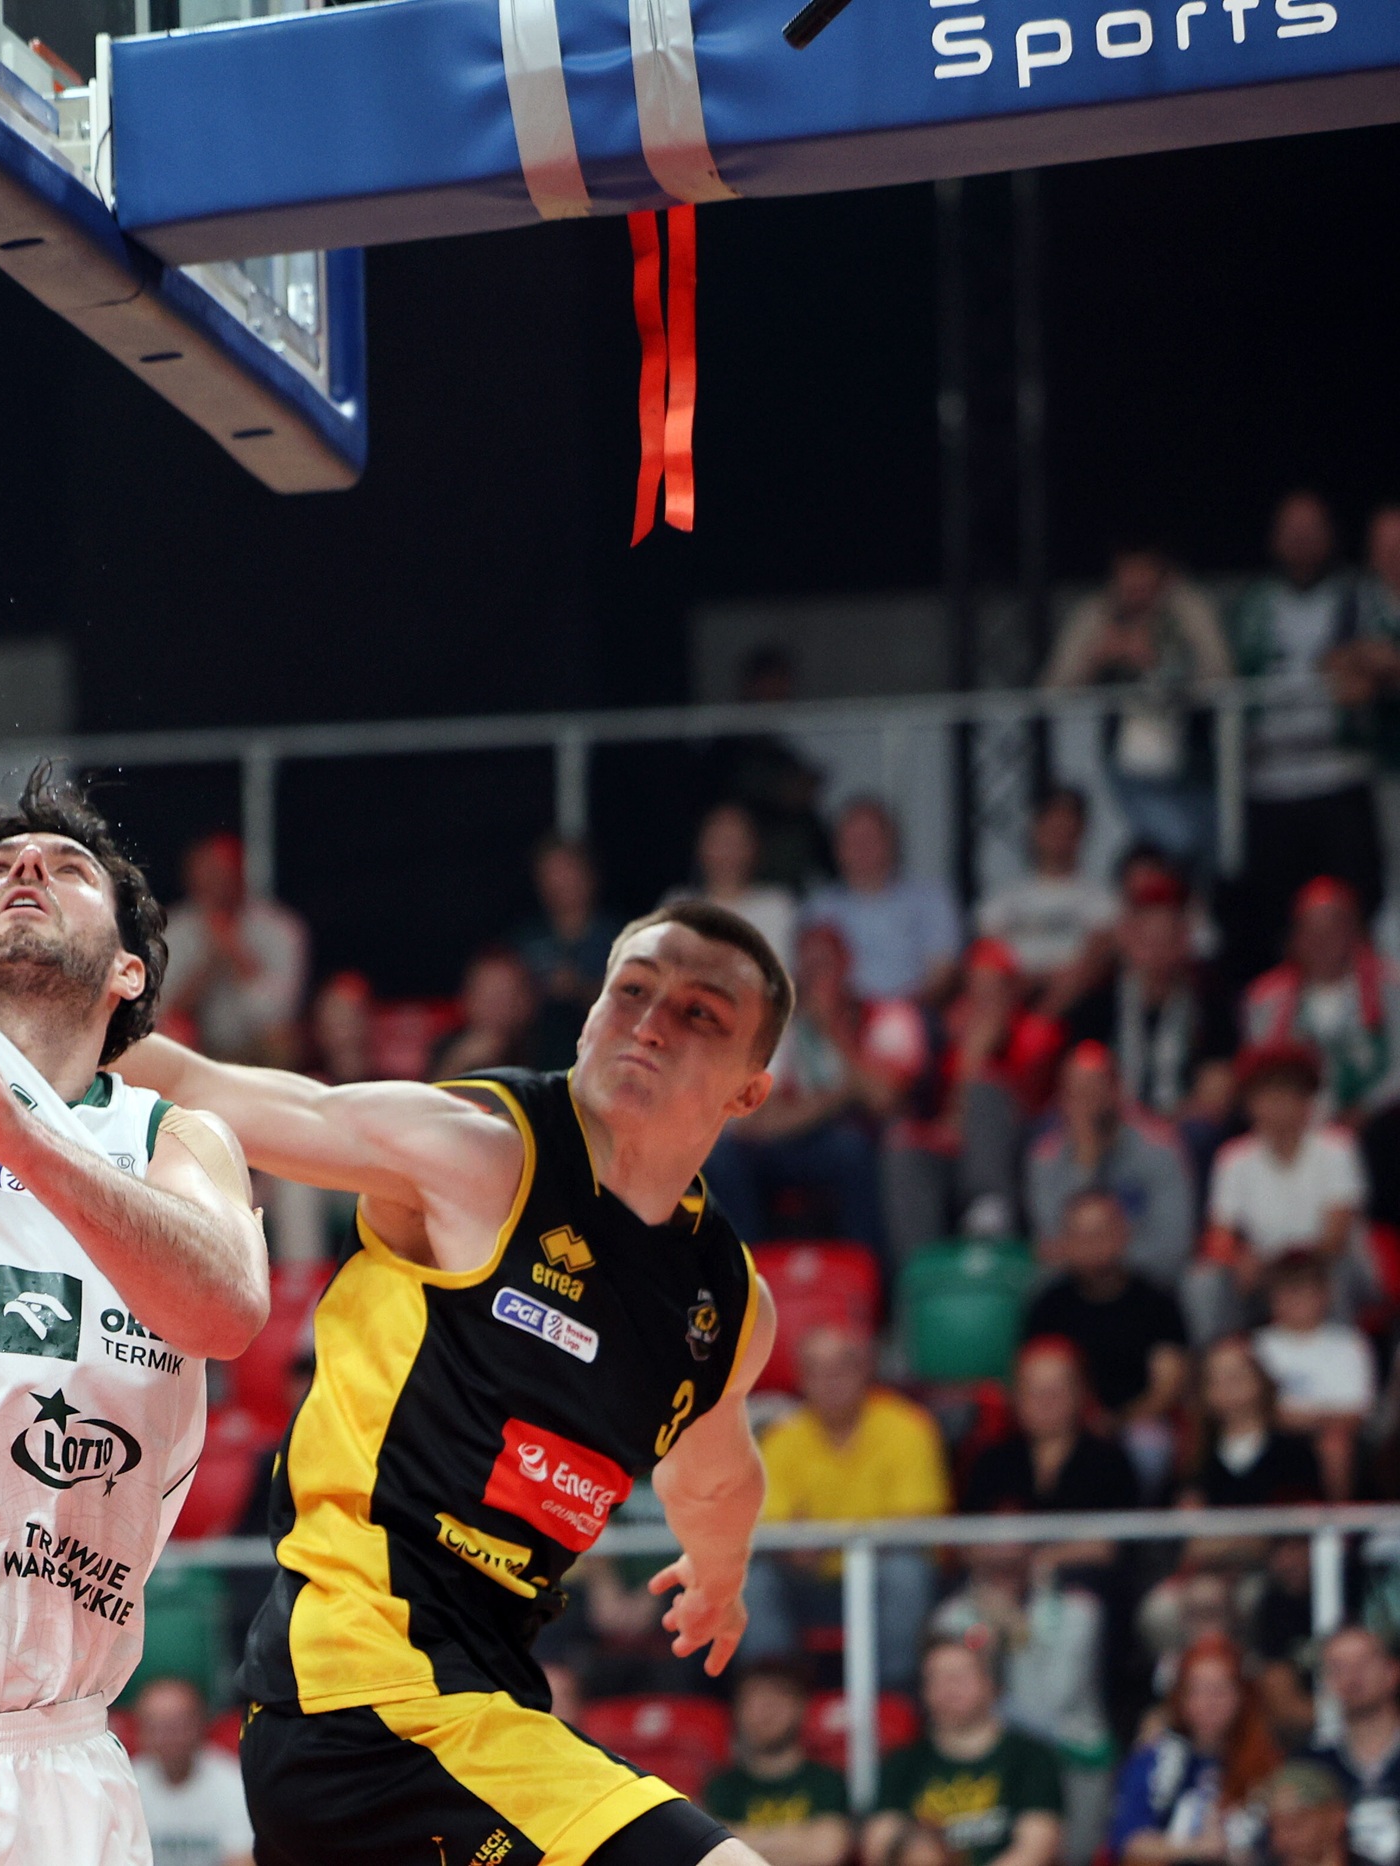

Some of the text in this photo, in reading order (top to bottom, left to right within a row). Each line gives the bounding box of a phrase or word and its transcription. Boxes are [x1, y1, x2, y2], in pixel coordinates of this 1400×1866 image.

[503, 1298, 543, 1327] PGE
[44, 1429, 114, 1474] LOTTO
[475, 1828, 507, 1861] LECH
